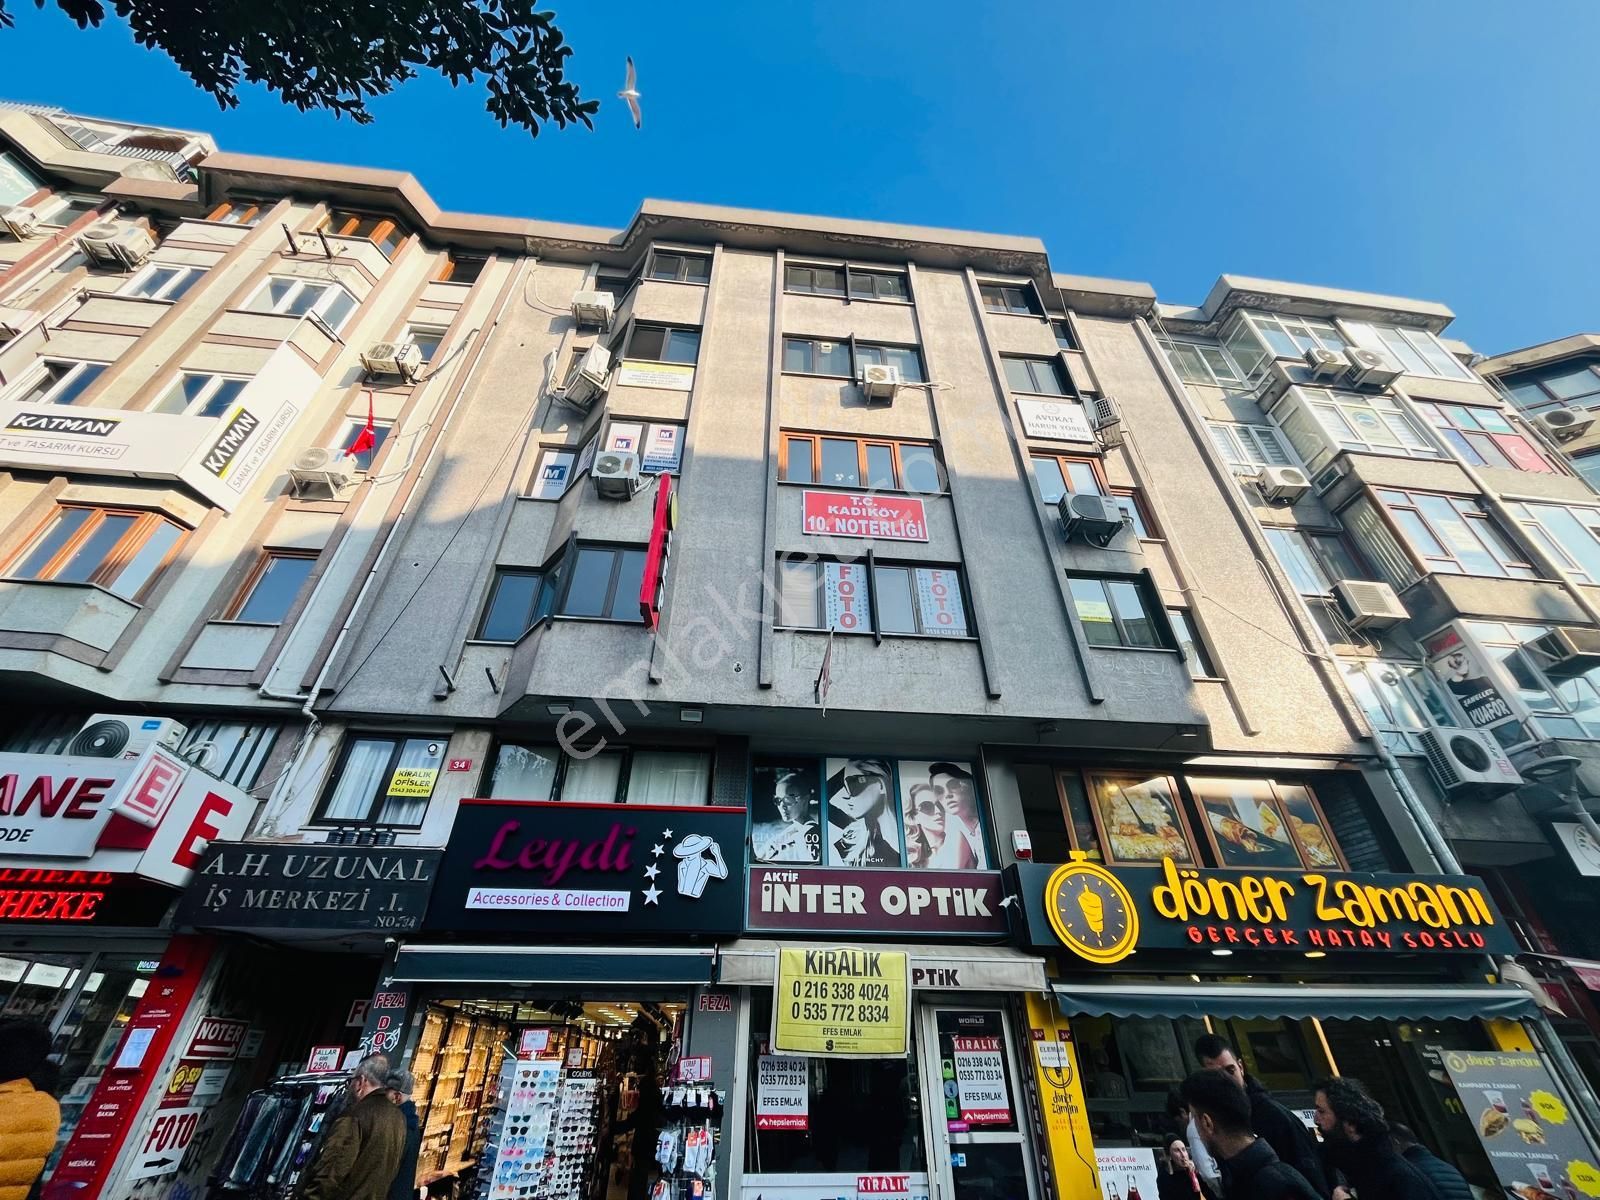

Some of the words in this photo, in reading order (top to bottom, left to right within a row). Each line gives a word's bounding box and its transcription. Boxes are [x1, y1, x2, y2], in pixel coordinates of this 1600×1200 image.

[13, 414, 115, 435] KATMAN
[1035, 414, 1073, 423] AVUKAT
[23, 441, 77, 452] TASARIM
[79, 445, 121, 456] KURSU
[205, 411, 258, 475] KATMAN
[231, 466, 252, 489] SANAT
[256, 428, 281, 461] TASARIM
[277, 405, 295, 431] KURSU
[850, 496, 877, 506] T.C.
[828, 505, 899, 518] KADIKÖY
[807, 515, 830, 532] 10.
[835, 517, 924, 538] NOTERLİĞİ
[838, 565, 857, 629] FOTO
[931, 571, 953, 625] FOTO
[1469, 697, 1511, 725] KUAFÖR
[453, 761, 466, 769] 34
[395, 778, 430, 787] OFİSLER
[473, 819, 638, 886] Leydi
[282, 854, 429, 882] UZUNAL
[763, 869, 799, 882] AKTİF
[204, 884, 231, 912] İŞ
[240, 888, 370, 911] MERKEZİ
[472, 891, 550, 905] Accessories
[551, 894, 560, 906] &
[564, 893, 625, 907] Collection
[880, 885, 993, 917] OPTİK
[1152, 856, 1296, 924] döner
[1303, 874, 1495, 929] zamanı
[0, 890, 104, 920] HEKE
[1186, 926, 1299, 947] GERÇEK
[1308, 929, 1392, 948] HATAY
[1403, 932, 1485, 949] SOSLU
[804, 950, 882, 977] KİRALIK
[912, 968, 960, 987] PTİK
[792, 980, 801, 998] 0
[804, 981, 828, 999] 216
[831, 982, 855, 1000] 338
[858, 984, 889, 1001] 4024
[373, 992, 406, 1009] FEZA
[699, 993, 732, 1012] FEZA
[791, 1001, 800, 1019] 0
[803, 1002, 827, 1020] 535
[831, 1003, 854, 1021] 772
[858, 1005, 889, 1023] 8334
[197, 1022, 244, 1042] NOTER
[822, 1027, 839, 1036] EFES
[840, 1028, 862, 1037] EMLAK
[761, 1060, 775, 1071] 0216
[776, 1061, 788, 1072] 338
[789, 1061, 797, 1072] 40
[798, 1061, 806, 1072] 24
[958, 1057, 971, 1067] 0216
[972, 1058, 984, 1067] 338
[984, 1058, 992, 1067] 40
[993, 1058, 1000, 1068] 24
[760, 1074, 776, 1085] 0535
[777, 1075, 788, 1085] 772
[789, 1075, 797, 1086] 83
[798, 1075, 806, 1086] 34
[959, 1070, 974, 1081] 0535
[975, 1071, 987, 1081] 772
[987, 1071, 994, 1081] 83
[994, 1071, 1002, 1081] 34
[762, 1097, 779, 1107] EFES
[780, 1097, 802, 1107] EMLAK
[964, 1092, 980, 1101] EFES
[981, 1092, 1002, 1101] EMLAK
[768, 1118, 806, 1127] hepsiemlak
[973, 1111, 1009, 1121] hepsiemlak
[143, 1113, 199, 1154] FOTO
[68, 1158, 96, 1167] MEDİKAL
[1097, 1164, 1118, 1172] ezzeti
[1111, 1155, 1127, 1163] Cola
